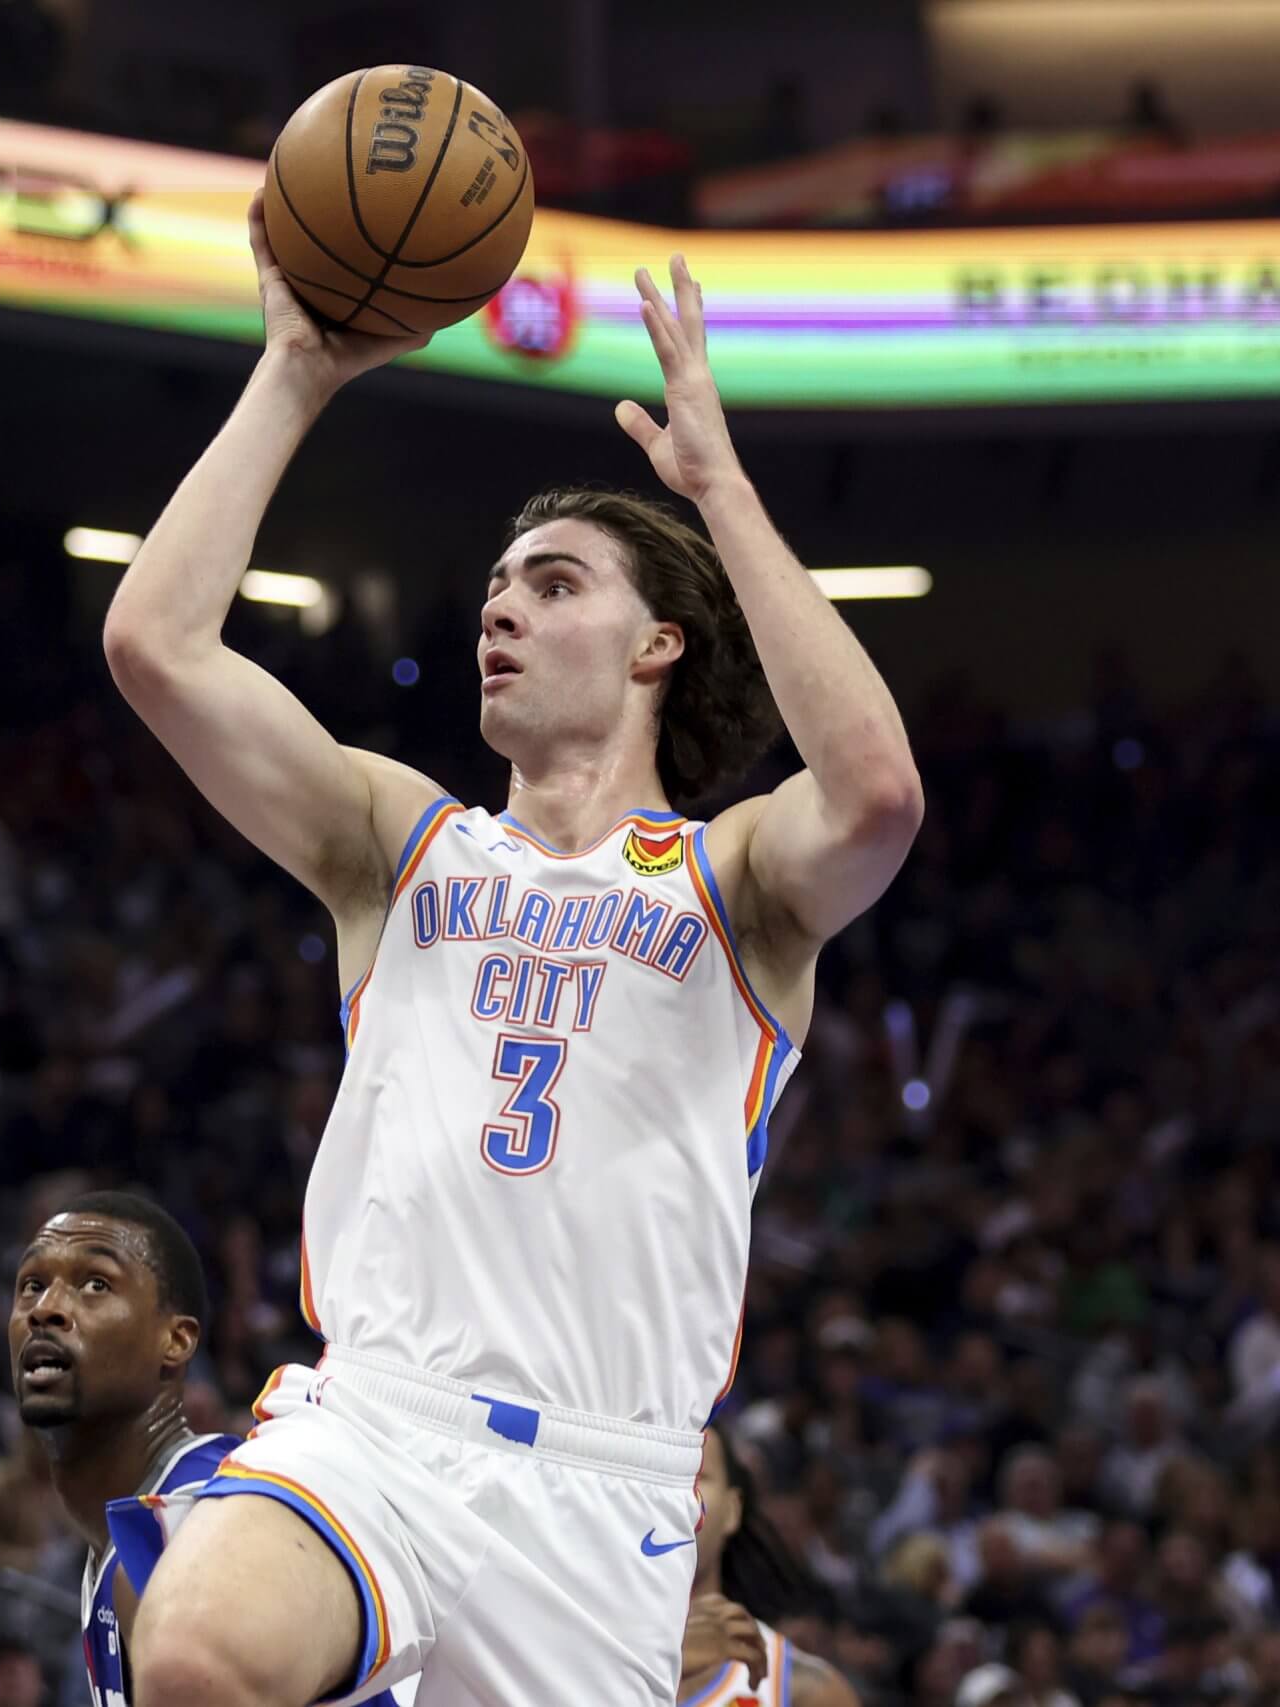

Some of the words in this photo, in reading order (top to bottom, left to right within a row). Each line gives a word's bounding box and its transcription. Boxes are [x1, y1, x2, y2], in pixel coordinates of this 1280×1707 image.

[366, 69, 434, 175] Wilso
[411, 874, 708, 982] OKLAHOMA
[470, 953, 607, 1032] CITY
[480, 1032, 568, 1176] 3
